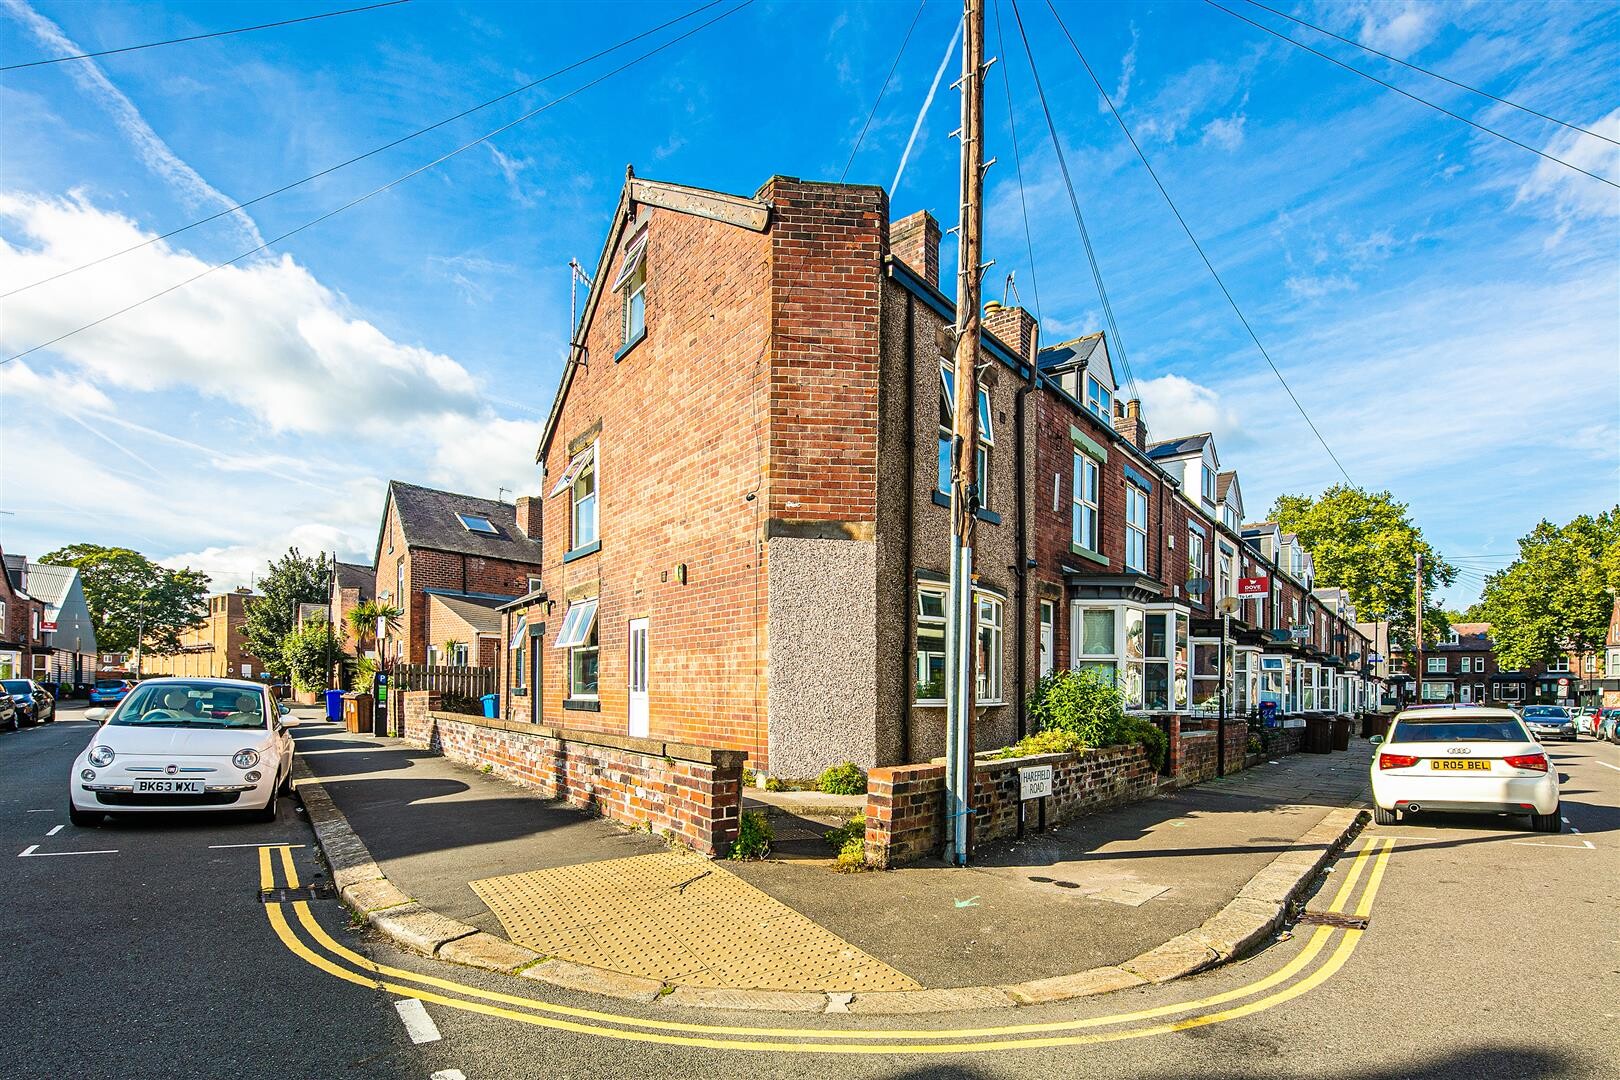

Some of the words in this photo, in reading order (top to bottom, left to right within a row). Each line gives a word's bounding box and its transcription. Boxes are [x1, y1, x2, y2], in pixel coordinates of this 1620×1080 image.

[1467, 761, 1489, 770] BEL
[1023, 769, 1051, 783] HAREFIELD
[139, 781, 173, 792] BK63
[175, 781, 199, 792] WXL
[1029, 782, 1045, 795] ROAD
